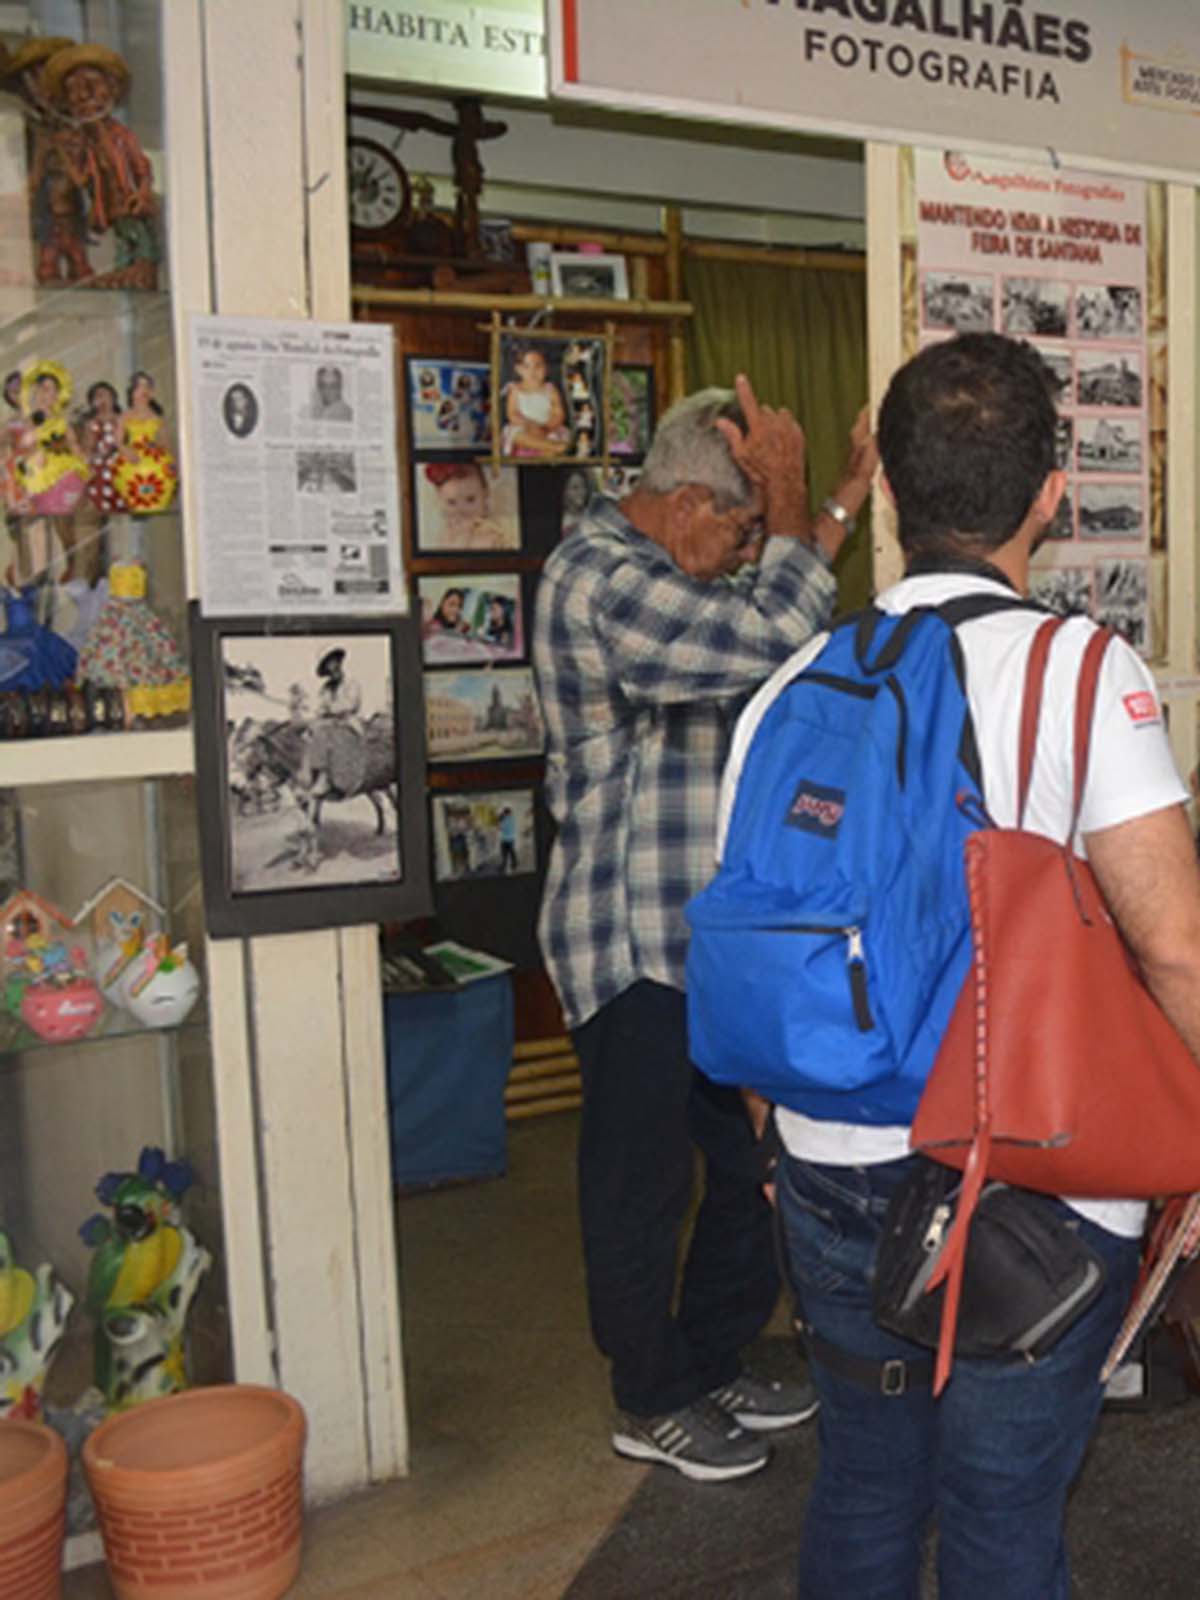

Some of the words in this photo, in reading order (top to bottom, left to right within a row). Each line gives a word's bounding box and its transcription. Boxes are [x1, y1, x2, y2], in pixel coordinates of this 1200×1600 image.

[349, 4, 470, 48] HABITA
[484, 25, 546, 55] EST
[766, 0, 1092, 63] GALHÃES
[804, 28, 1060, 104] FOTOGRAFIA
[920, 200, 1006, 231] MANTENDO
[1124, 223, 1142, 247] DE
[1015, 235, 1033, 260] DE
